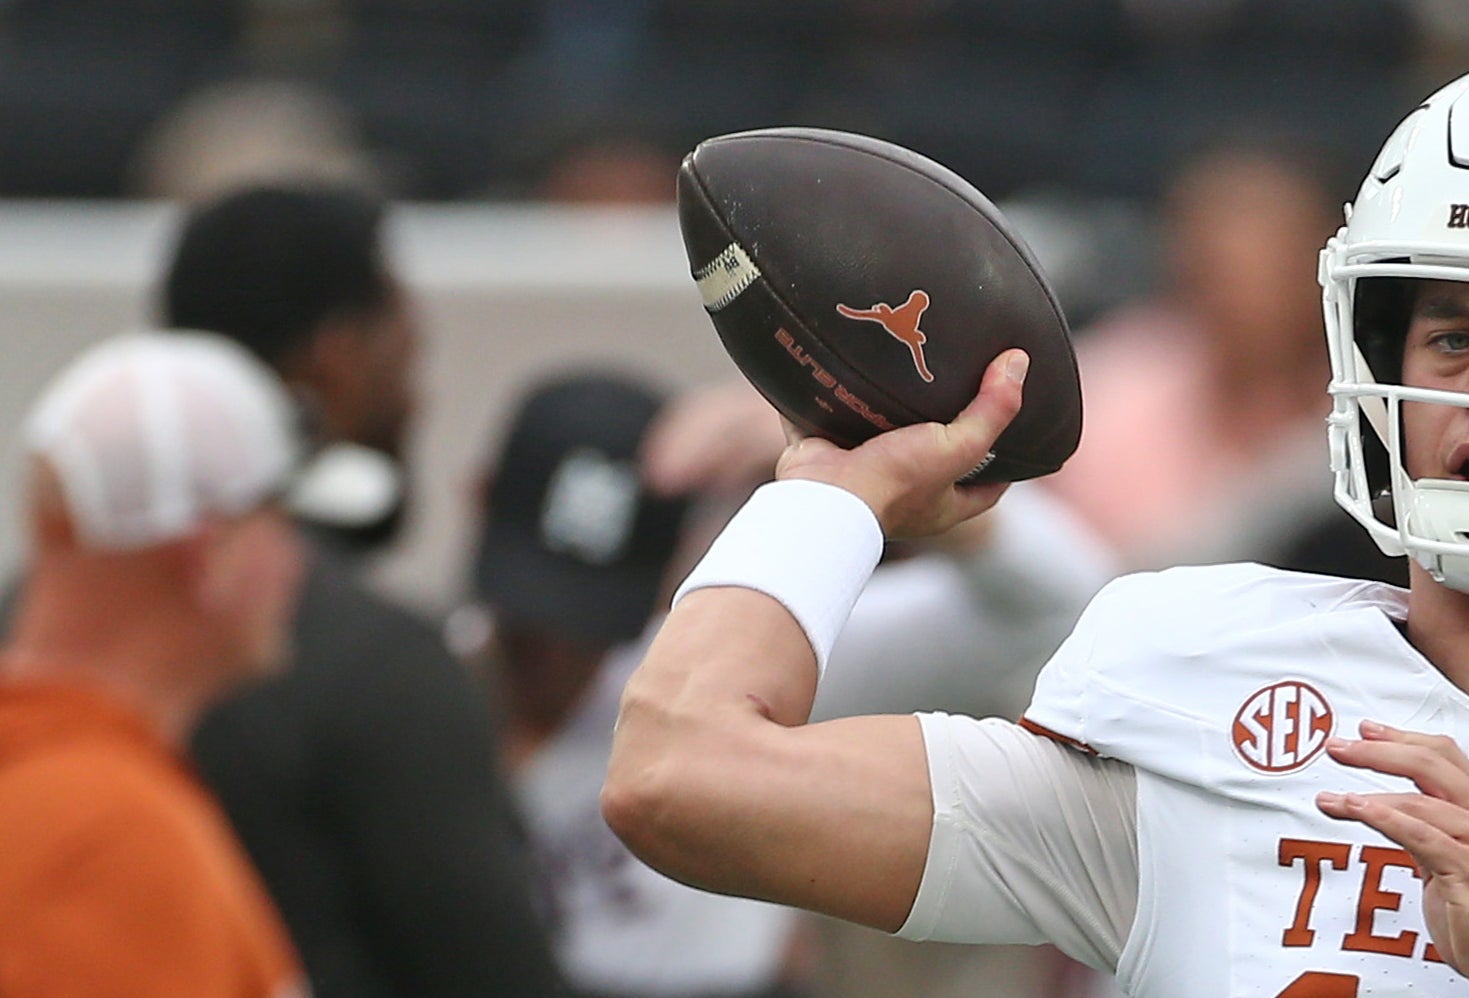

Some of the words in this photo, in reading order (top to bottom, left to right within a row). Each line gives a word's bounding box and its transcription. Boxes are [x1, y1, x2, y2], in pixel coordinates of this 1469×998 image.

[774, 327, 838, 388] ELITE
[834, 384, 900, 431] APOR
[1237, 685, 1329, 769] SEC
